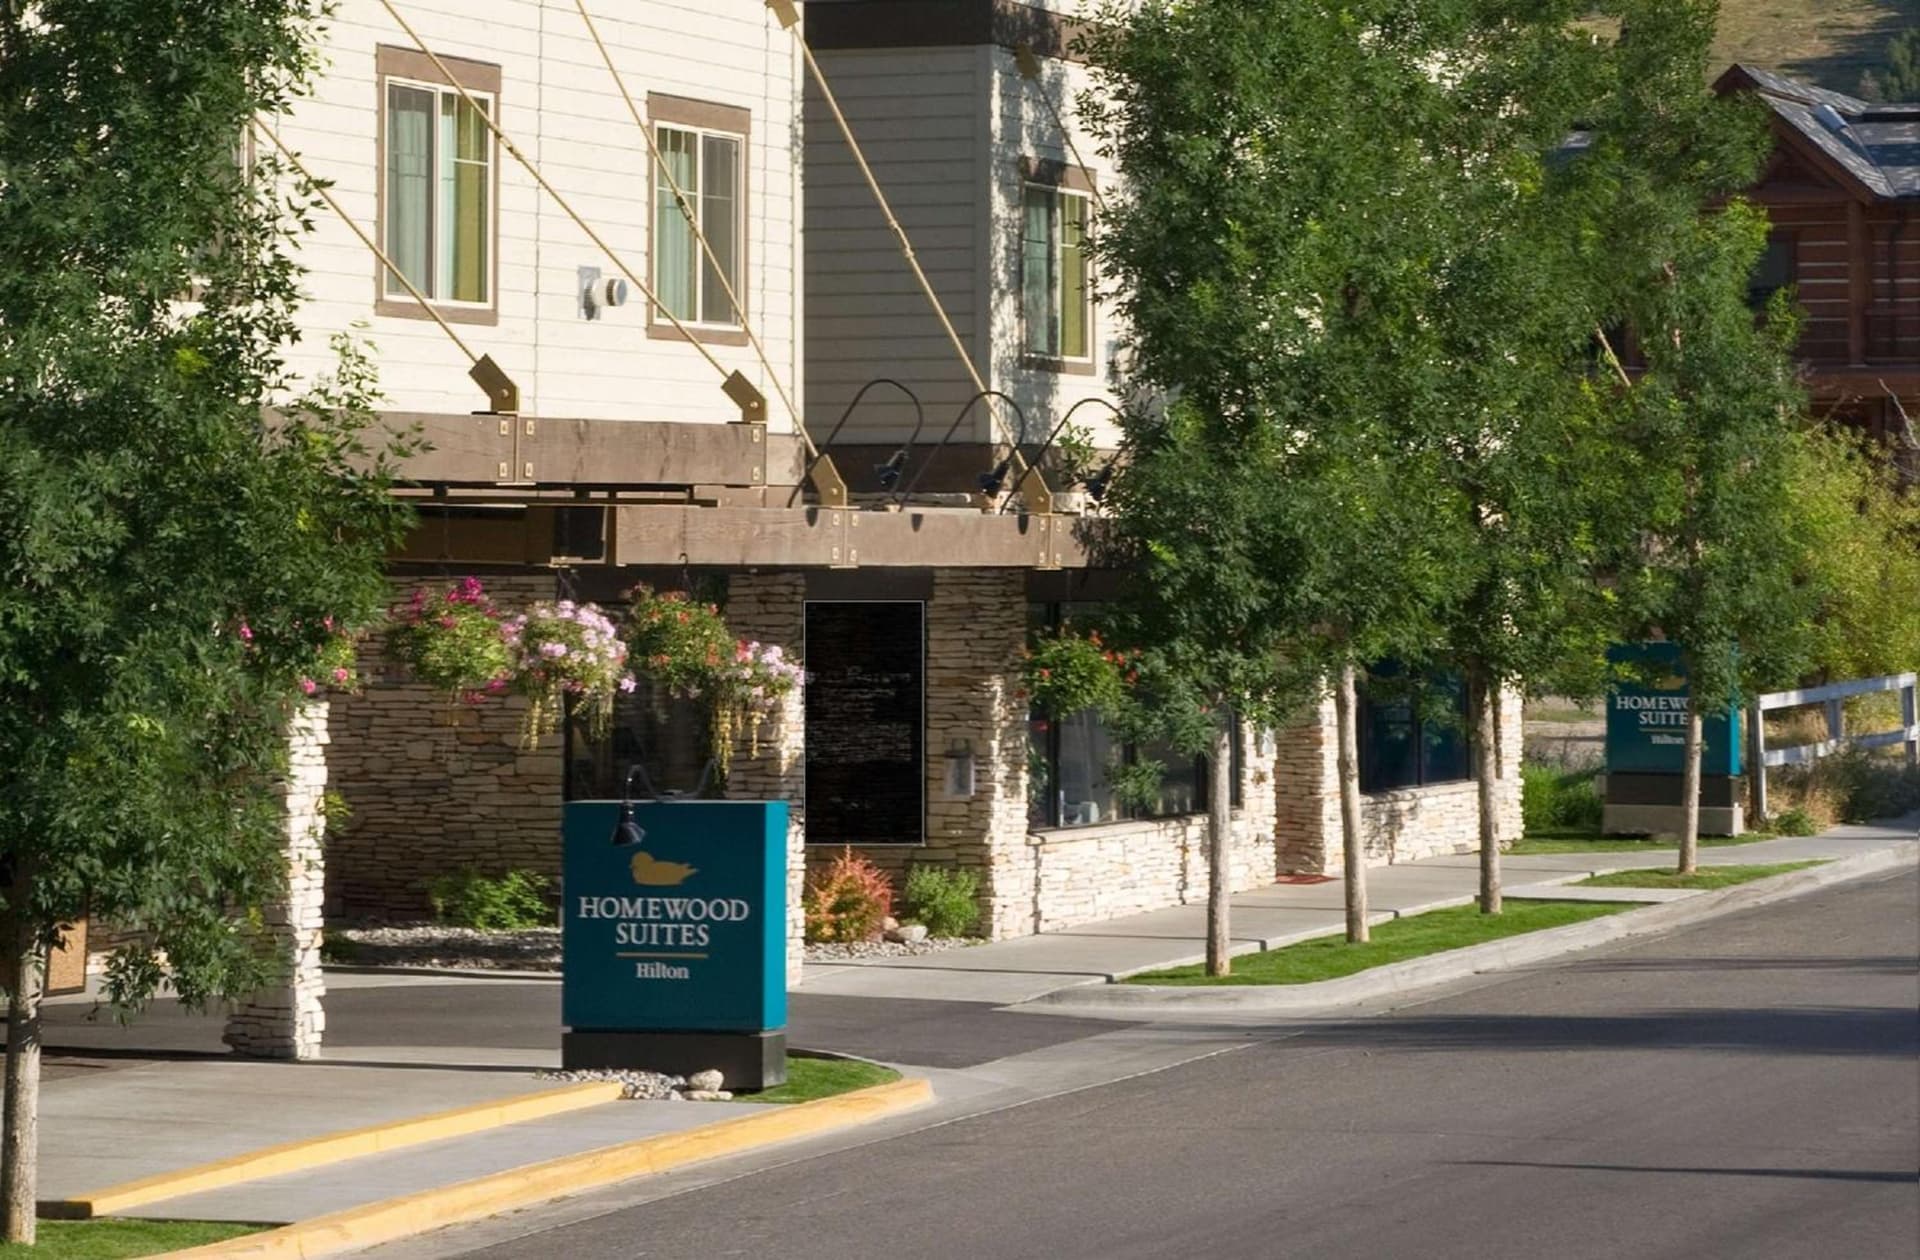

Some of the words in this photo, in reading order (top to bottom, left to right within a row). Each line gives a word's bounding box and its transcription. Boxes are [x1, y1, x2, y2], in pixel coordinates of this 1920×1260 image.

[1616, 695, 1689, 710] HOMEW
[1639, 711, 1689, 726] SUITE
[578, 896, 749, 921] HOMEWOOD
[615, 923, 710, 946] SUITES
[636, 962, 690, 979] Hilton
